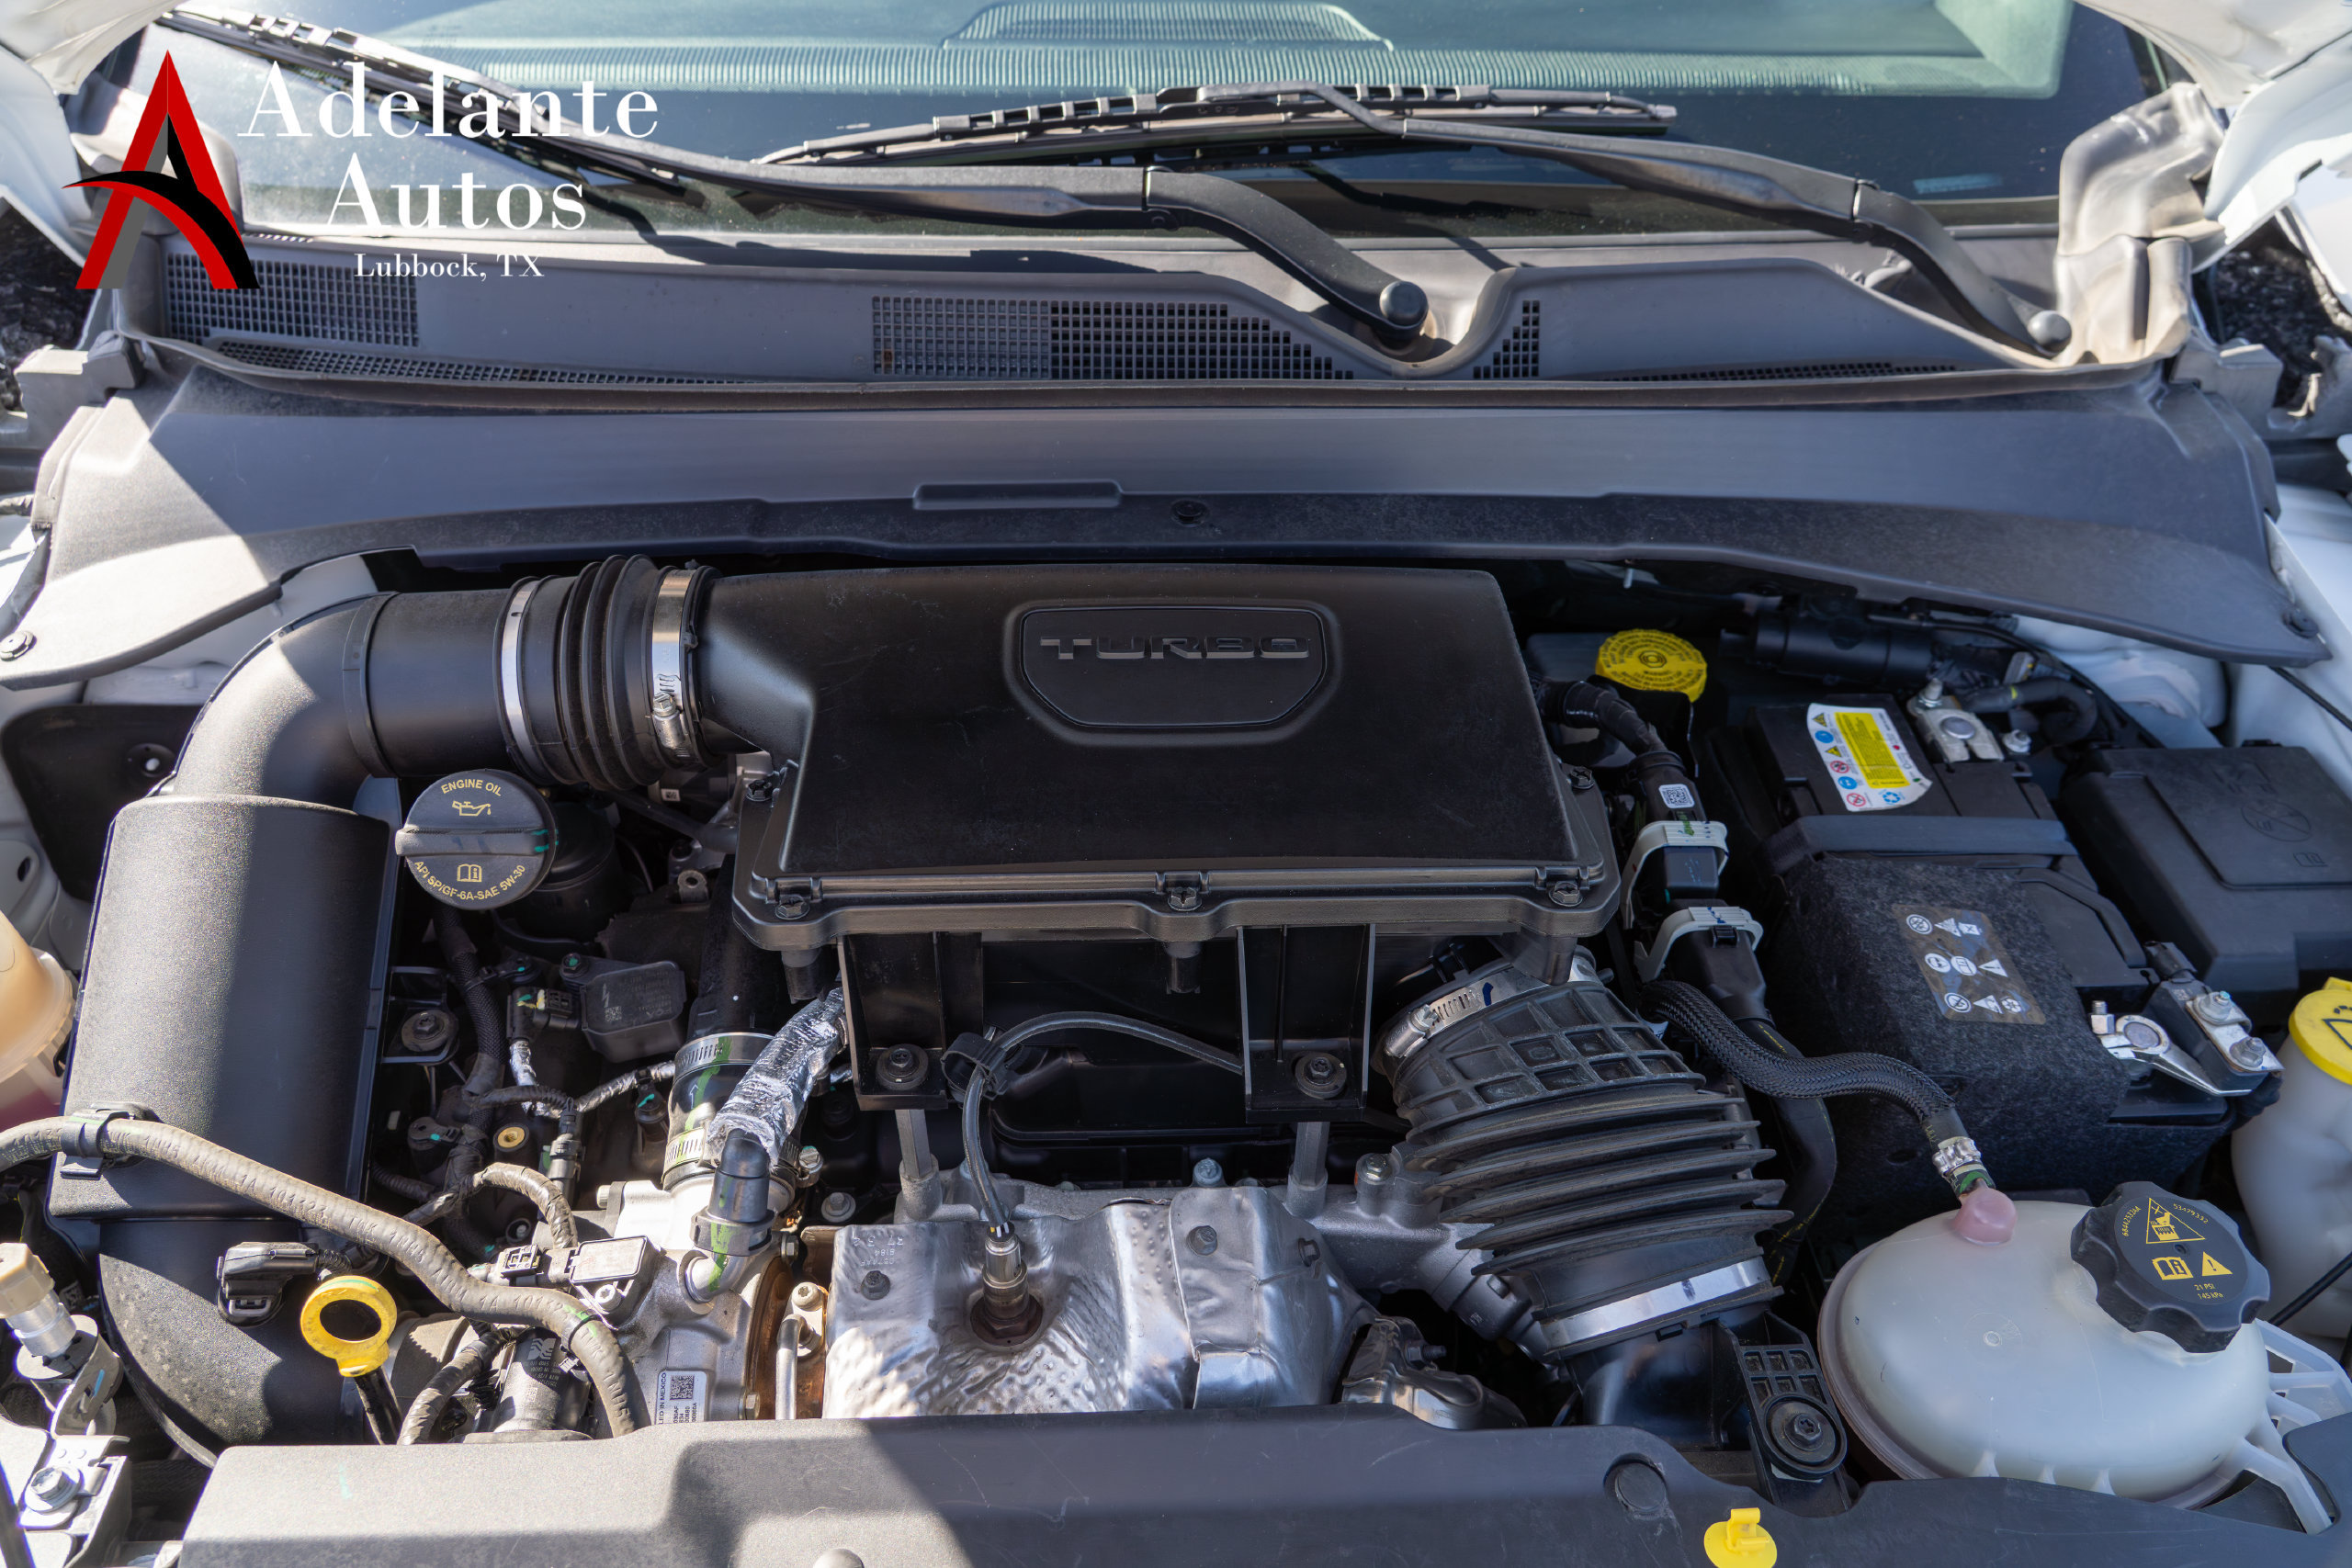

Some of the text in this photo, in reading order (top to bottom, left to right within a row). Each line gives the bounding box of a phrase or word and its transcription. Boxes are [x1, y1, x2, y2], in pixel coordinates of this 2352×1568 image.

[1040, 637, 1309, 660] TURBO
[440, 778, 503, 797] ENGINE OIL
[414, 860, 431, 879] API
[500, 864, 526, 891] 5W-30
